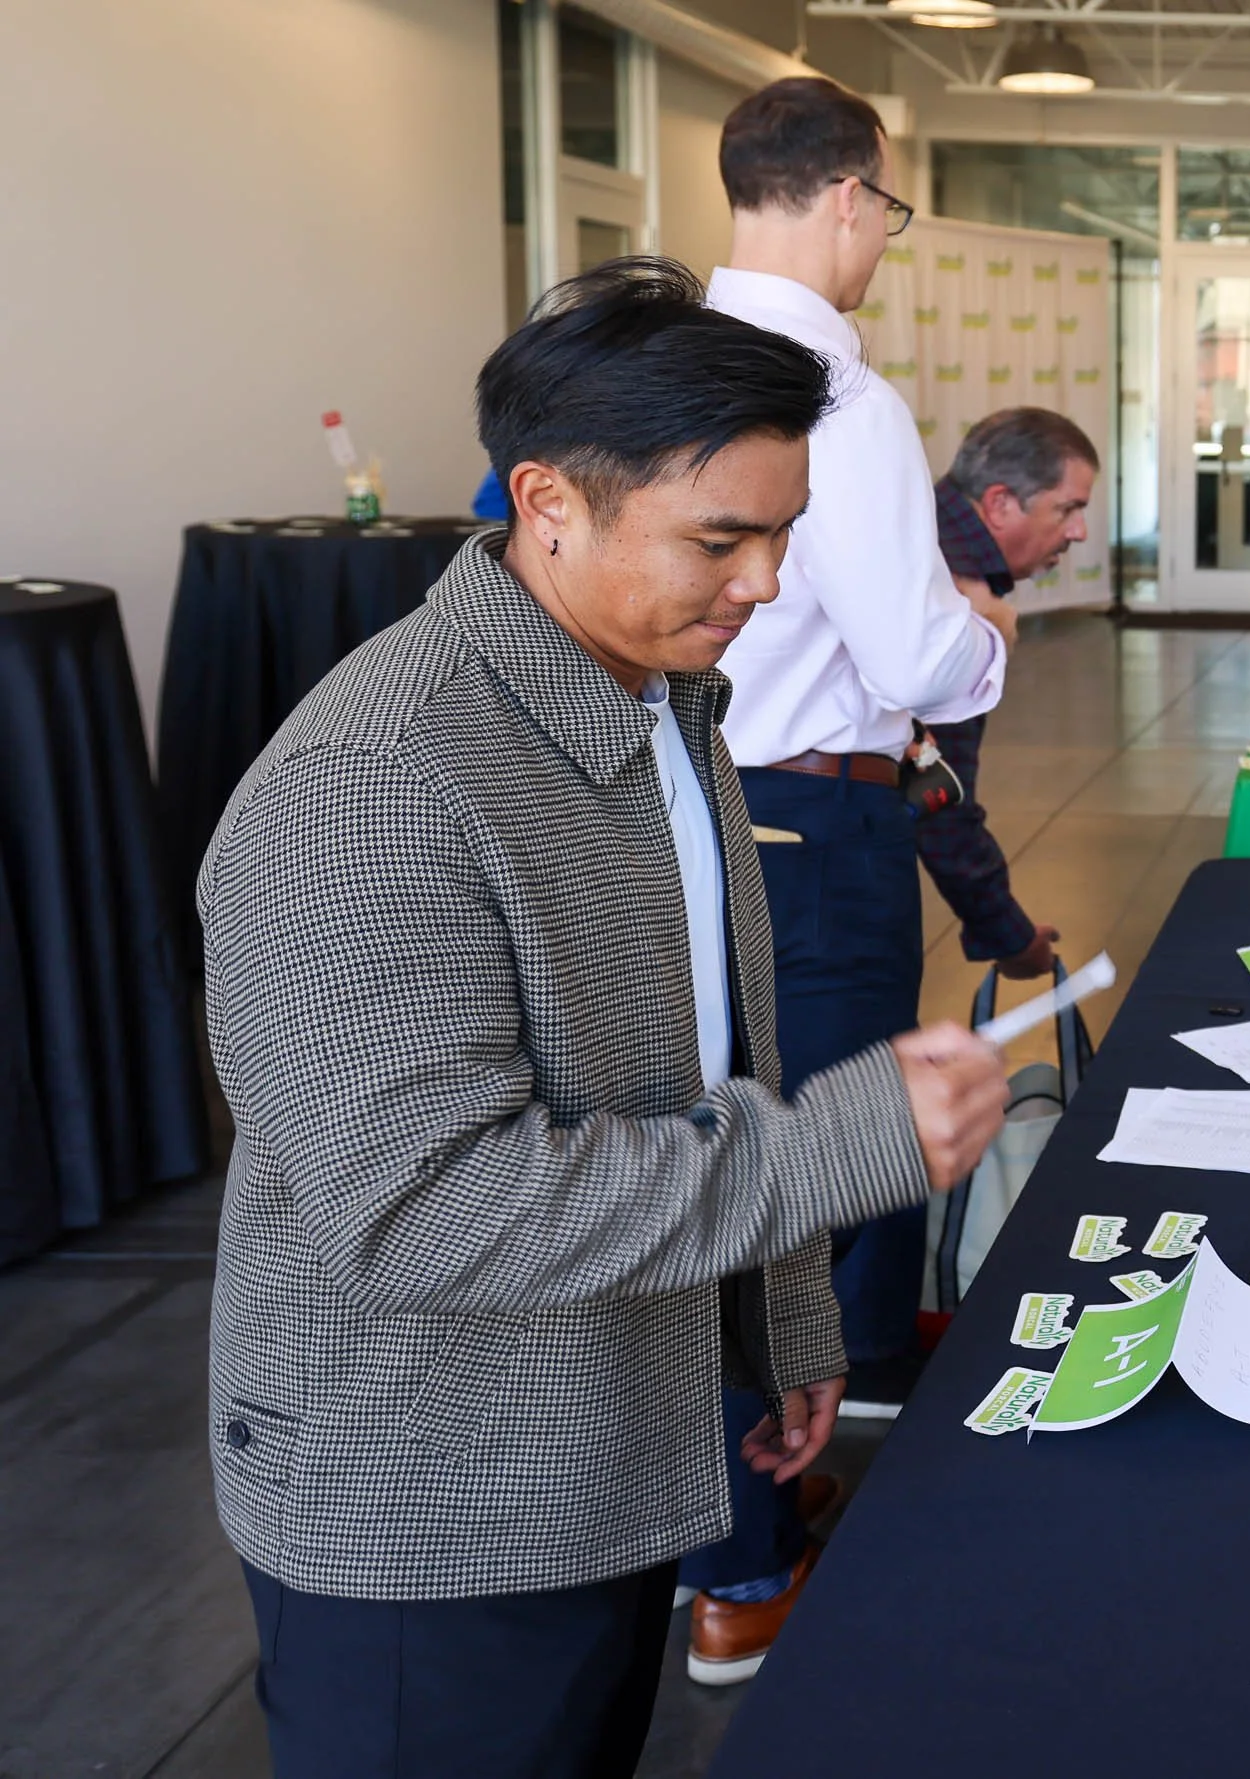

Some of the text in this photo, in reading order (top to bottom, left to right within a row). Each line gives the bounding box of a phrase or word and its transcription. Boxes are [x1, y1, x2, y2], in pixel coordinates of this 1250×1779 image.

[1088, 1219, 1119, 1260] Naturally
[1163, 1216, 1201, 1257] Naturally
[1029, 1297, 1069, 1346] Naturally
[981, 1375, 1051, 1431] Naturally
